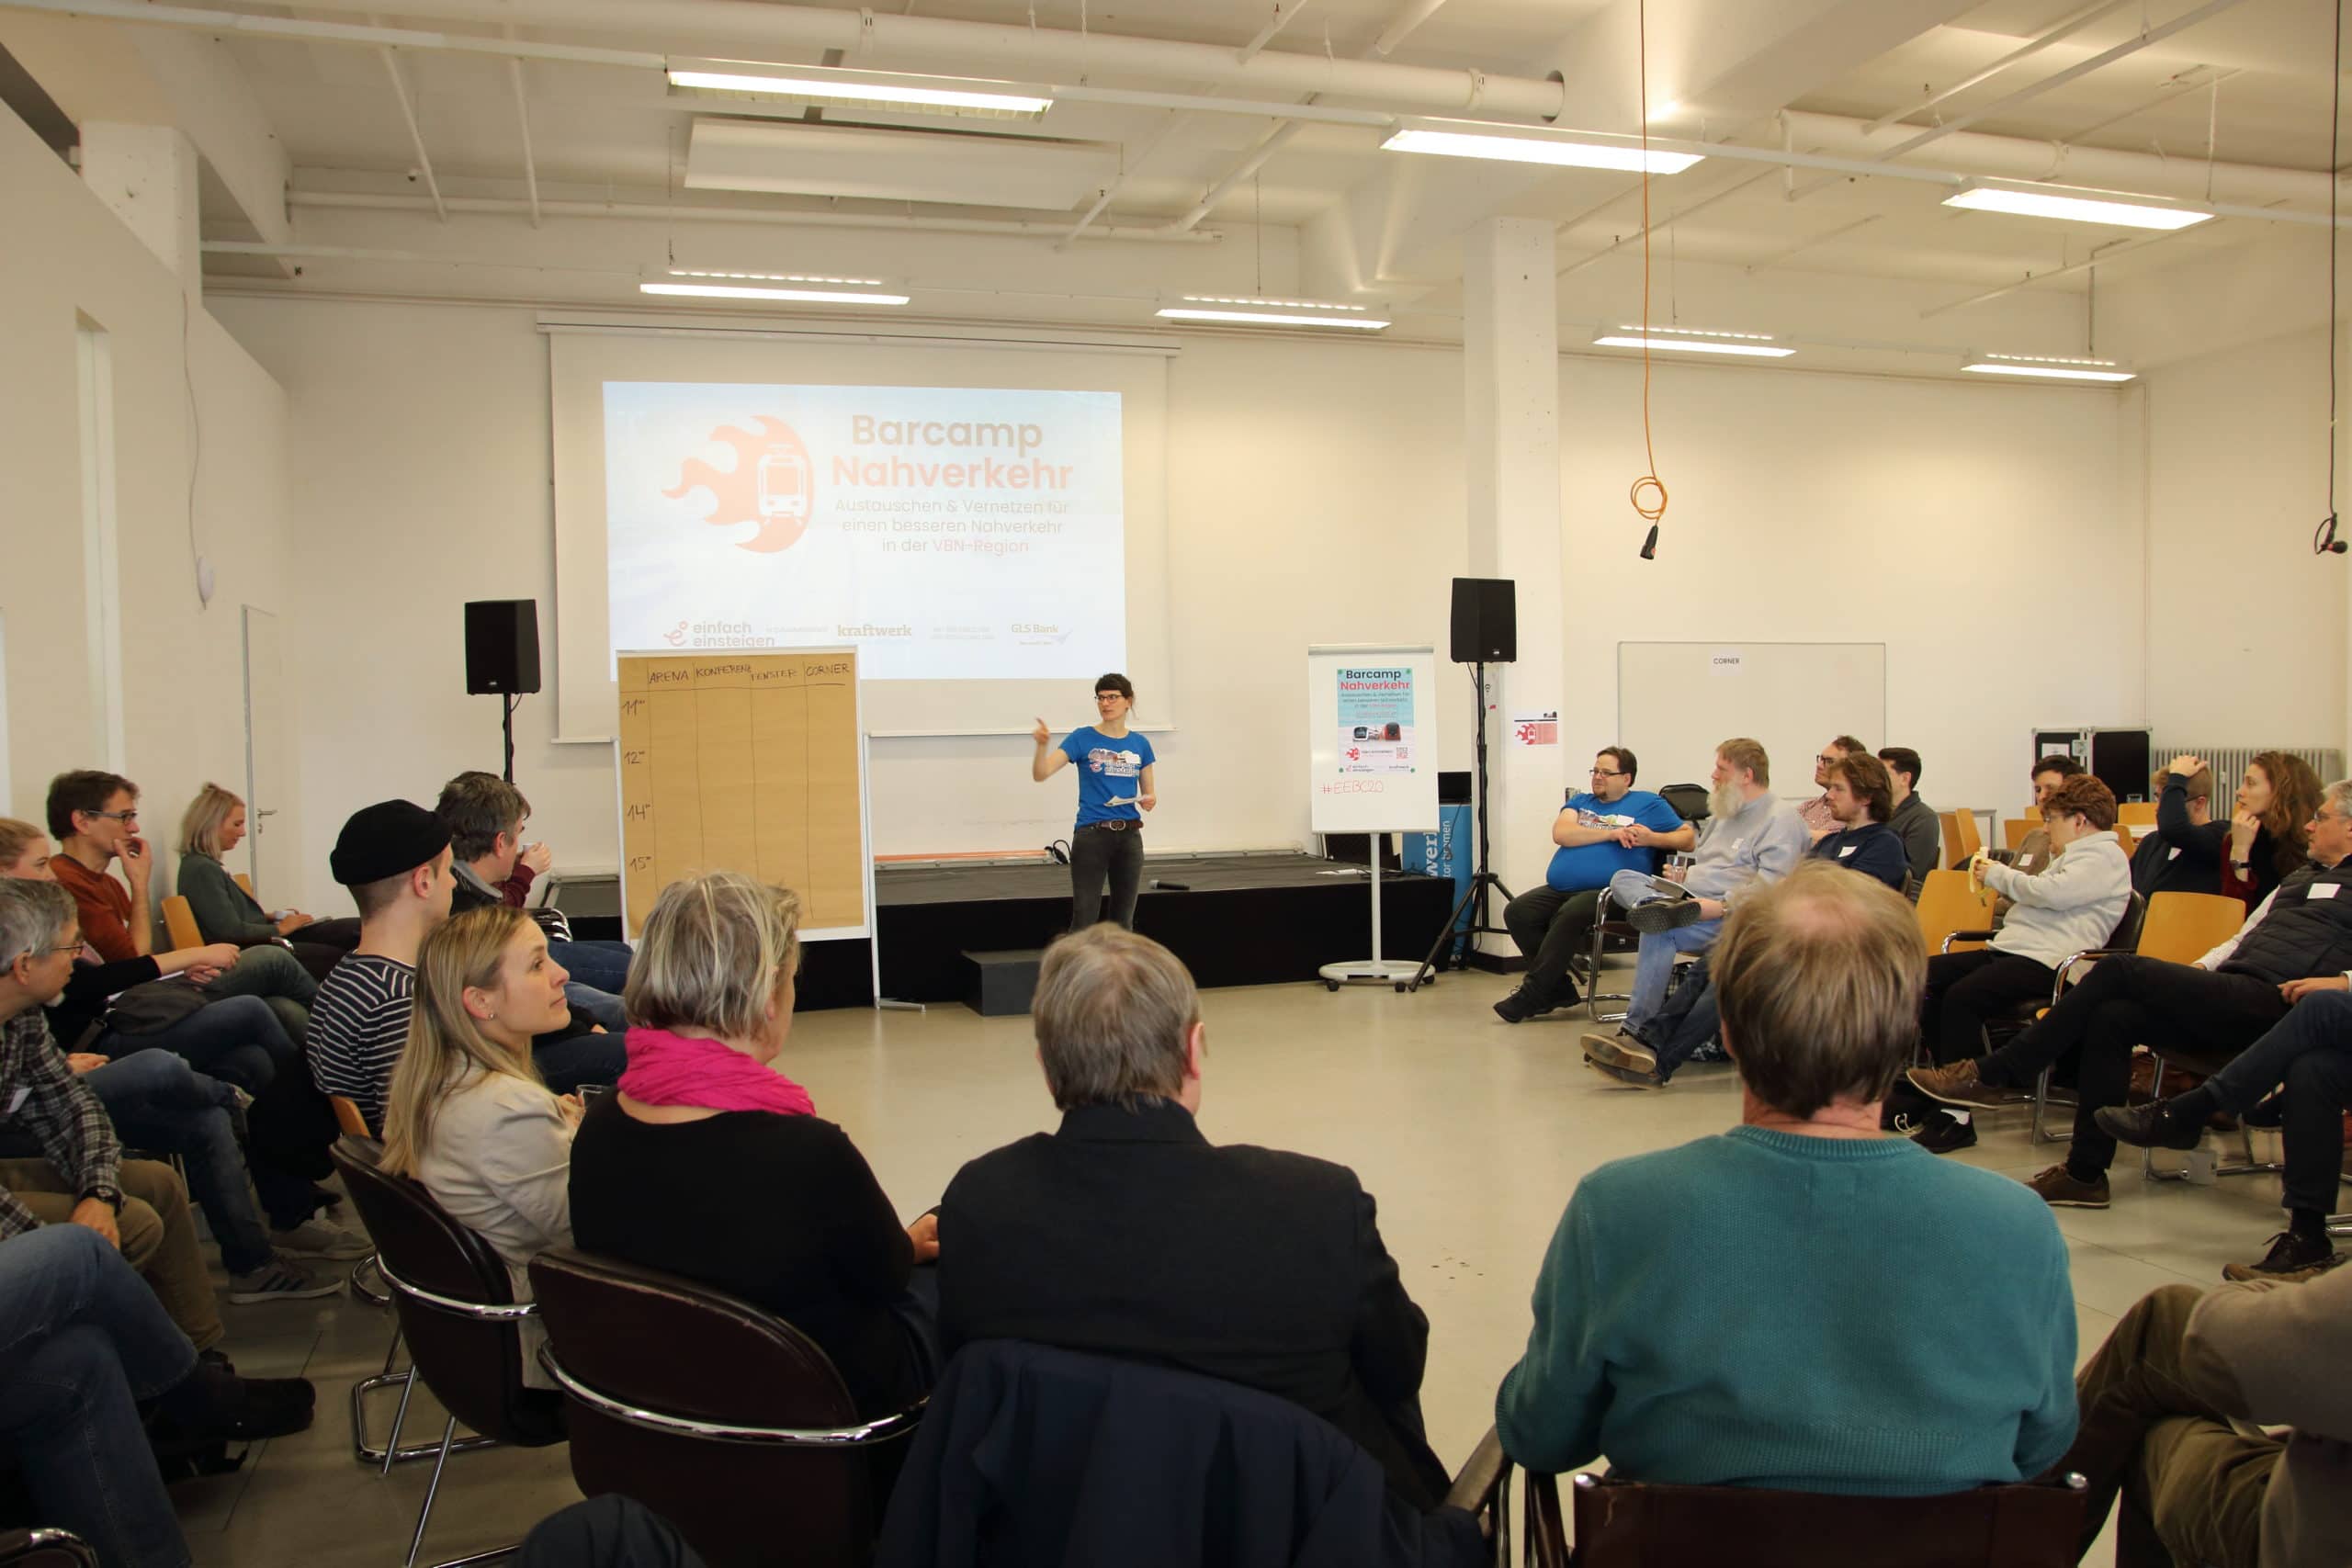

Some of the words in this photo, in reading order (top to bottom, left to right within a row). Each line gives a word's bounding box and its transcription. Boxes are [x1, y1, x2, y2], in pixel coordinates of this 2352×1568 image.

[853, 414, 1043, 457] Barcamp
[831, 456, 1073, 490] Nahverkehr
[836, 499, 942, 514] Austauschen
[946, 500, 957, 514] &
[963, 499, 1044, 515] Vernetzen
[1048, 500, 1069, 515] für
[842, 518, 888, 532] einen
[892, 518, 967, 533] besseren
[971, 520, 1063, 535] Nahverkehr
[882, 538, 897, 552] in
[900, 538, 927, 552] der
[933, 538, 1030, 558] VBN-Region
[693, 621, 752, 635] einfach
[838, 624, 912, 637] kraftwerk
[1012, 624, 1032, 634] GLS
[1033, 624, 1059, 634] Bank
[693, 634, 775, 647] einsteigen
[1713, 657, 1740, 665] CORNER
[650, 671, 689, 684] ARENA
[806, 662, 849, 678] CORNER
[1346, 670, 1402, 682] Barcamp
[1340, 681, 1410, 691] Nahverkehr
